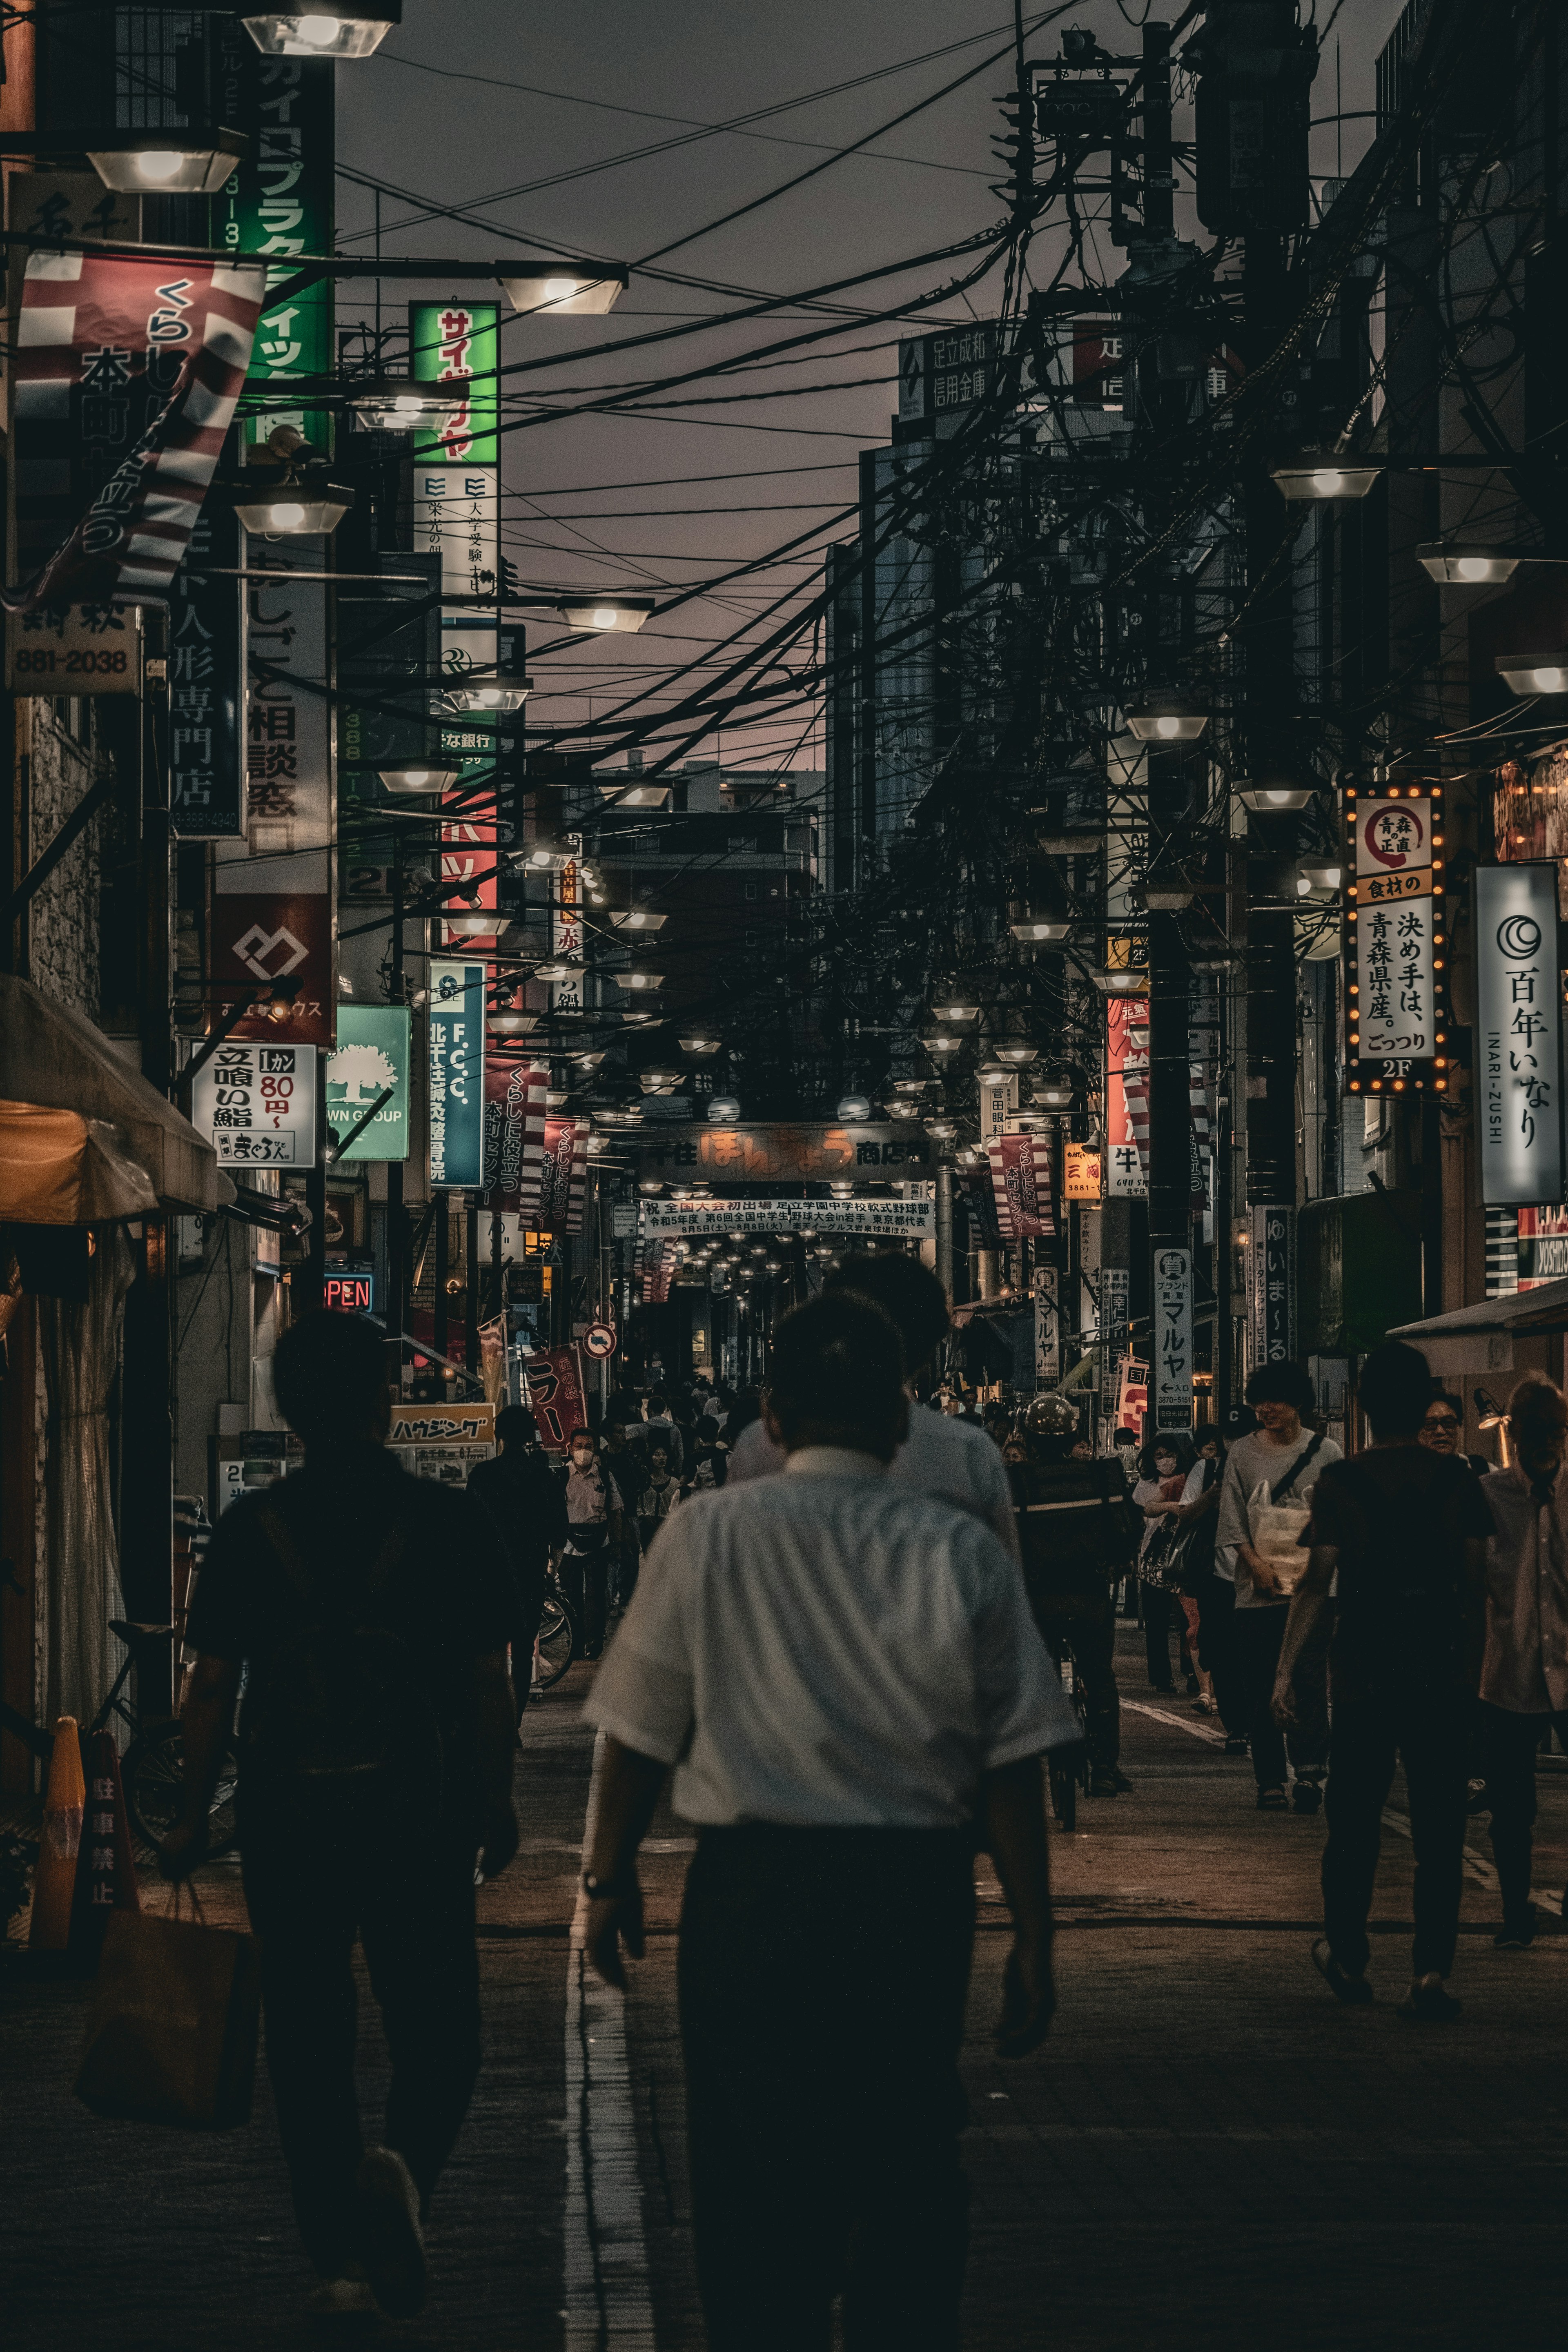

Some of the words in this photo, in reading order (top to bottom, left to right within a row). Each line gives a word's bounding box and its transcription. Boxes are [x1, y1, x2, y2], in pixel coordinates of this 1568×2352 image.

[933, 332, 985, 369] 足立成和
[933, 368, 985, 408] 信用金庫
[16, 649, 127, 673] 881-2038
[248, 551, 298, 856] おしごと相談窓口
[1379, 816, 1412, 834] 青森
[1380, 837, 1412, 853] 正直
[1367, 875, 1421, 899] 食材の
[558, 928, 579, 1014] 赤ら鍋
[1366, 911, 1394, 1028] 青森県産。
[1396, 911, 1424, 1022] 決め手は、
[261, 1050, 294, 1072] 1カン
[450, 1023, 469, 1105] F.C.C.
[1367, 1033, 1425, 1052] ごっつり
[1508, 967, 1552, 1149] 百年いなり
[213, 1047, 253, 1127] 立喰い鮨
[1383, 1059, 1413, 1079] 2F
[1487, 1031, 1503, 1145] INARI-ZUSHI
[352, 1110, 402, 1122] GOUP
[500, 1066, 524, 1192] くらしに役立つ
[992, 1088, 1004, 1134] 菅田眼科
[481, 1100, 502, 1205] 本町センター
[552, 1125, 571, 1220] くらしに役立つ
[536, 1151, 554, 1229] 本町センター
[1005, 1165, 1023, 1233] 本町センター
[1018, 1140, 1038, 1225] くらしに役立つ
[646, 1202, 660, 1215] 祝
[665, 1201, 772, 1214] 全国大会初出場
[650, 1214, 699, 1227] 令和5年度
[873, 1214, 926, 1227] 東京都代表
[1162, 1254, 1184, 1278] 質
[323, 1280, 369, 1307] PEN
[1038, 1305, 1053, 1357] マルヤ
[1163, 1303, 1185, 1378] マルヤ
[1158, 1396, 1191, 1404] 3870-5151
[227, 1465, 245, 1482] 2
[91, 1777, 115, 1905] 駐車禁止
